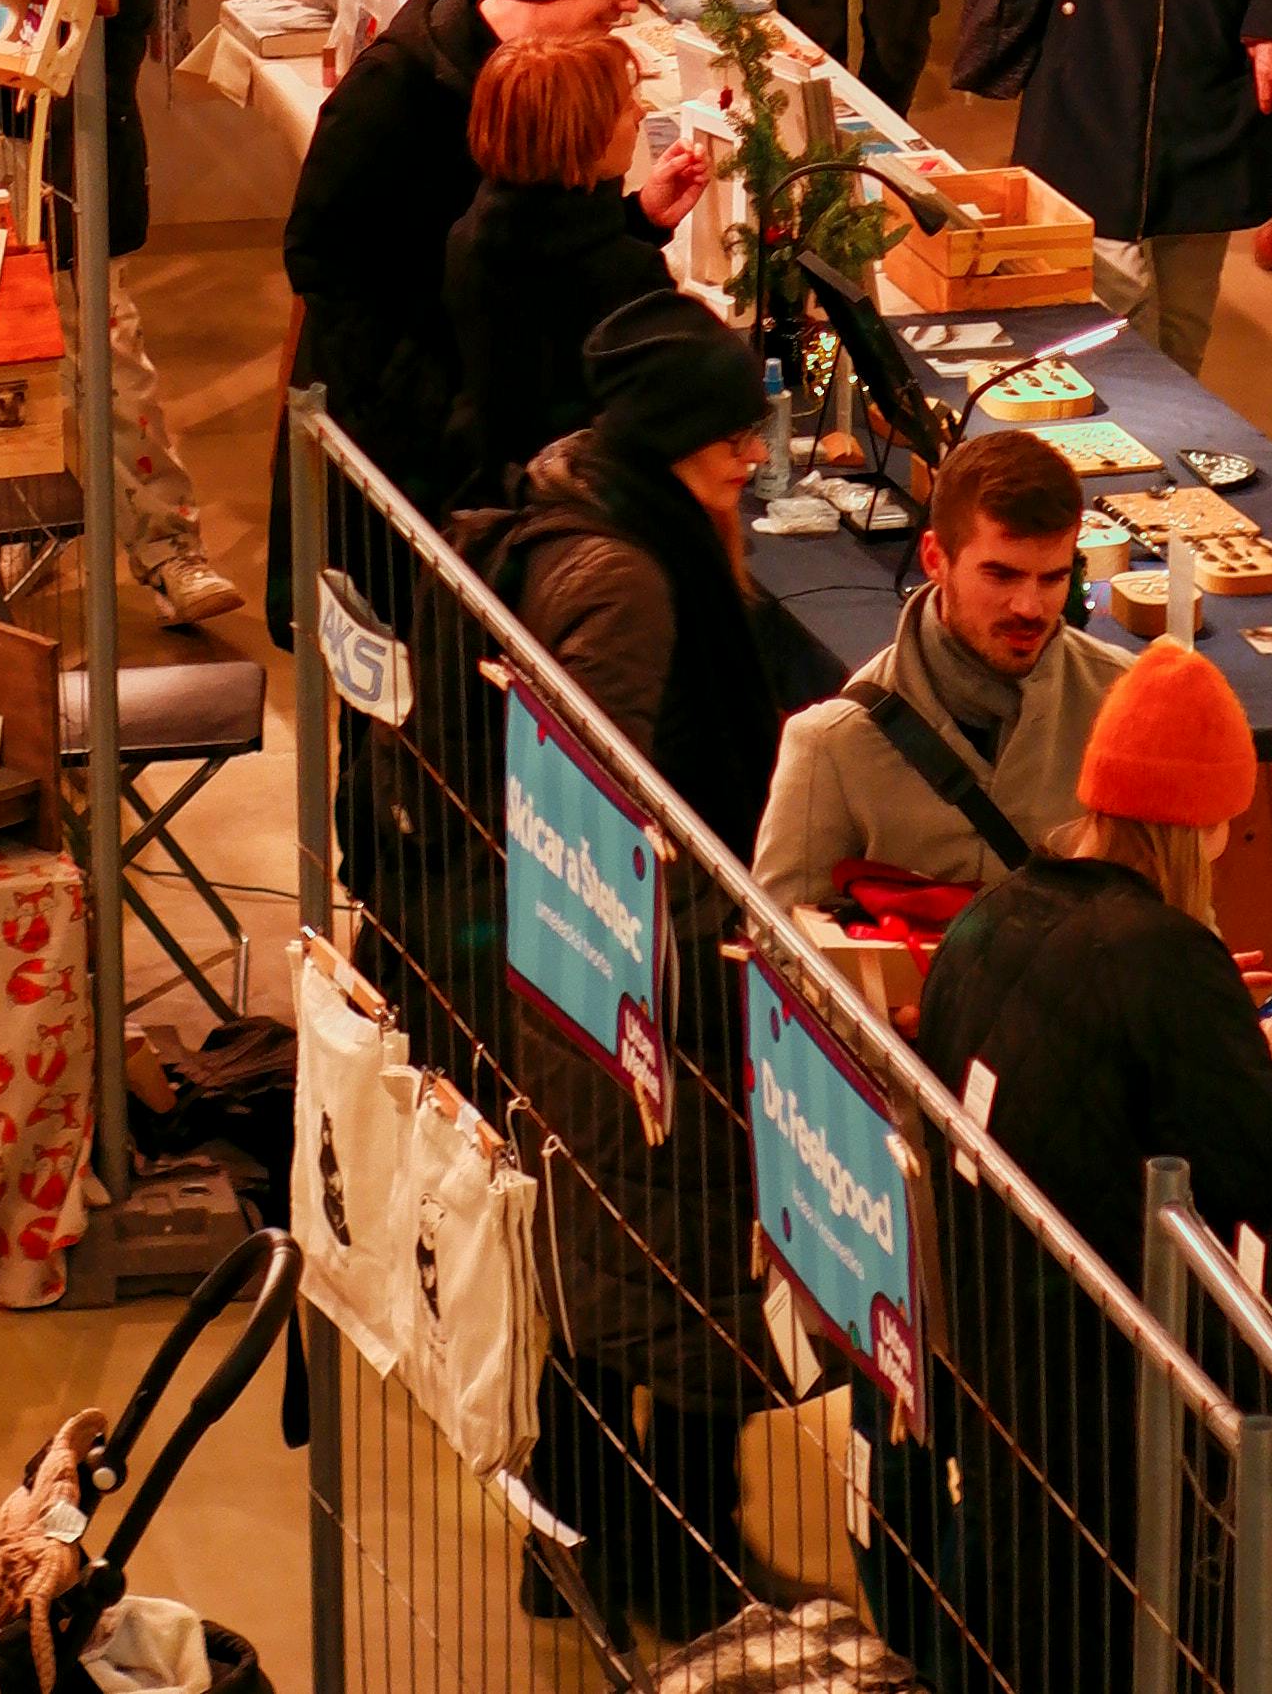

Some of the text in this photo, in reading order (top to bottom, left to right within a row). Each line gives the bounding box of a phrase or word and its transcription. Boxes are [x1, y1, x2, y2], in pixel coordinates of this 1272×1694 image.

[566, 846, 580, 896] a
[580, 835, 643, 964] Štetec
[621, 1037, 661, 1105] Market
[625, 1008, 657, 1069] Urban
[878, 1309, 912, 1374] Urban
[876, 1339, 915, 1413] Market
